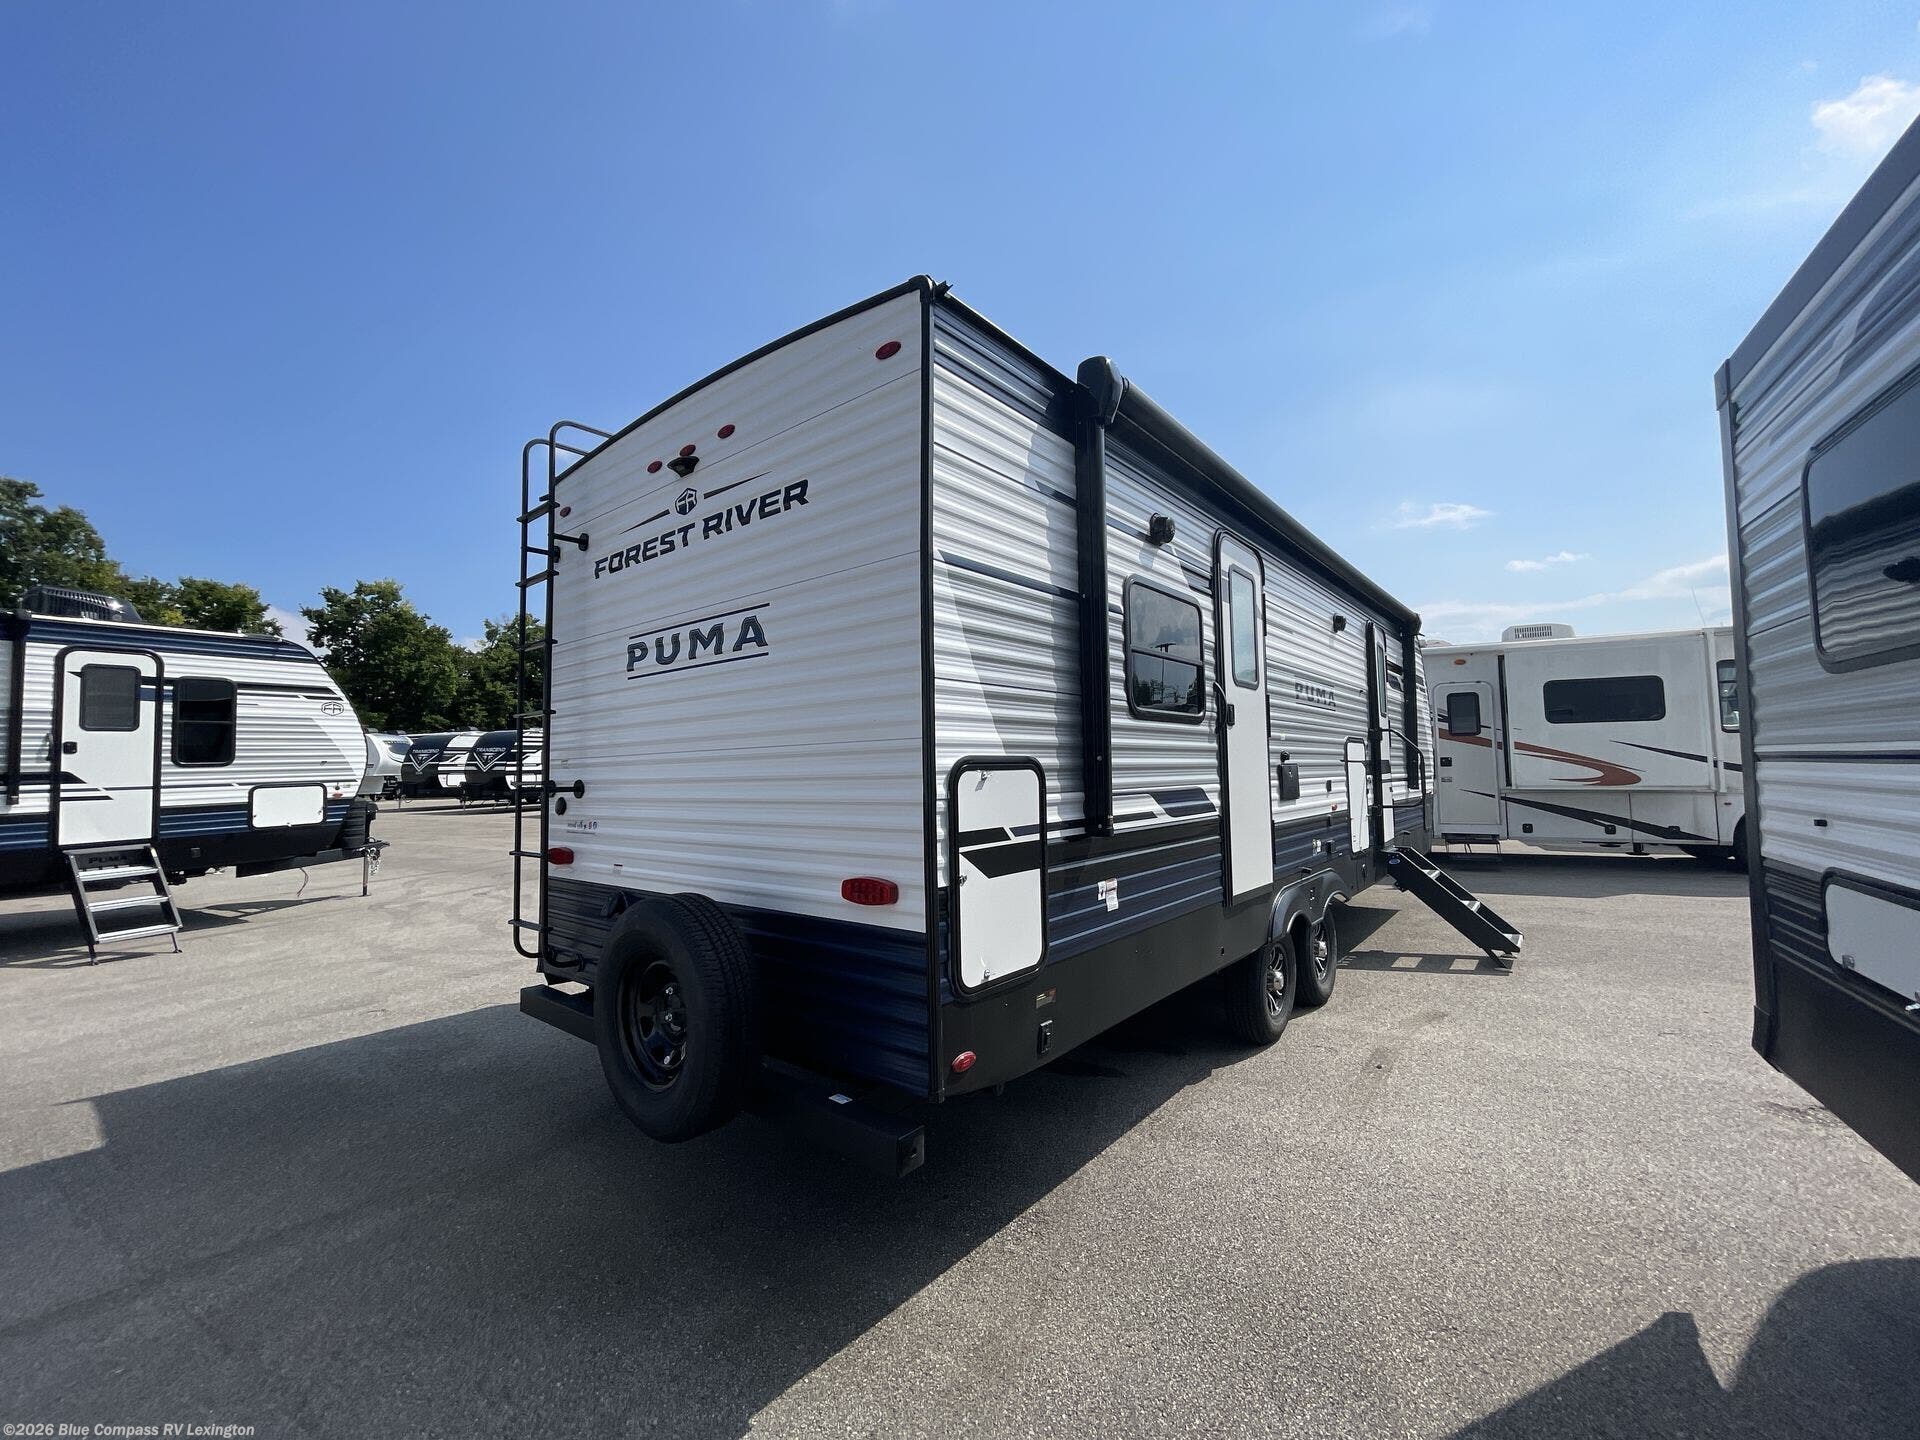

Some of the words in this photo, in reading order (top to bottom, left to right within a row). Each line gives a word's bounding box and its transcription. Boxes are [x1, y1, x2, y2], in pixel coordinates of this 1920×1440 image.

[594, 523, 695, 579] FOREST
[702, 479, 809, 539] RIVER
[626, 615, 768, 672] PUMA
[1295, 682, 1336, 707] PUMA
